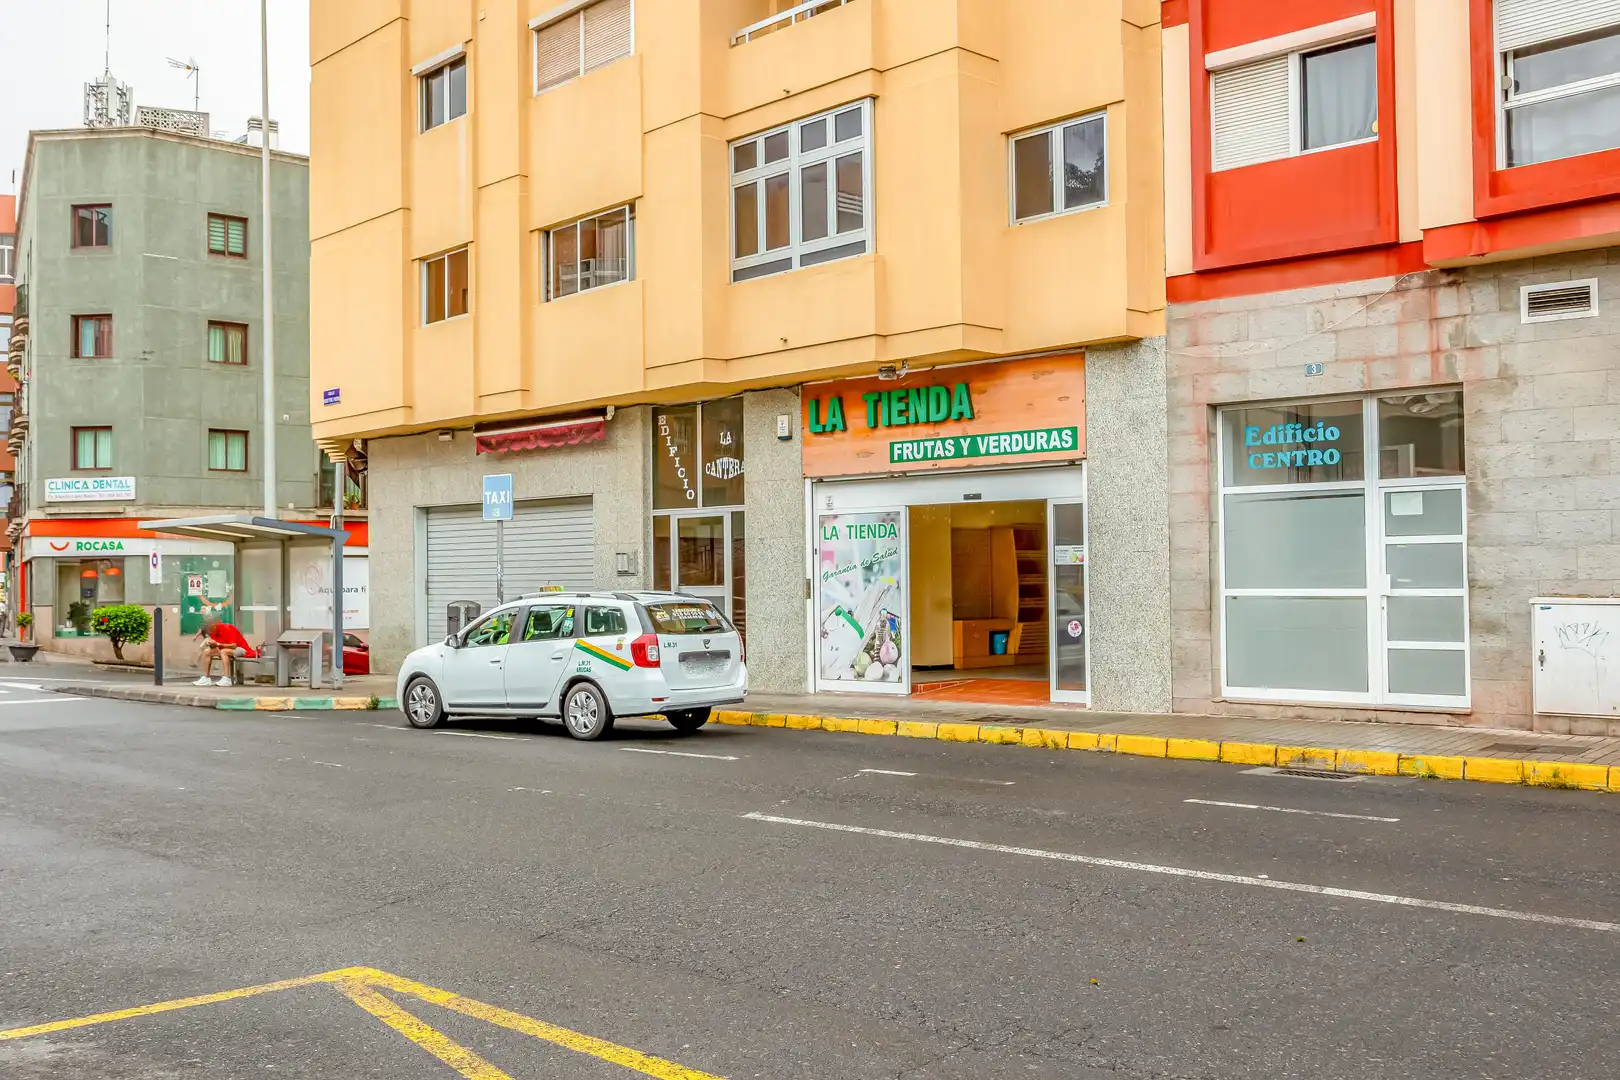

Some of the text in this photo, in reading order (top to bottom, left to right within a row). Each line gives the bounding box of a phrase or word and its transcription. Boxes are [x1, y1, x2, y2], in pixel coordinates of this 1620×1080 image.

[1311, 364, 1317, 374] 3
[808, 383, 975, 433] LA TIENDA
[720, 431, 732, 446] LA
[1244, 421, 1340, 447] Edificio
[893, 429, 1073, 461] FRUTAS Y VERDURAS
[658, 415, 695, 500] EDIFICIO
[1247, 448, 1341, 469] CENTRO
[48, 479, 131, 491] CLINICA DENTAL
[485, 490, 510, 505] TAXI
[823, 523, 898, 540] LA TIENDA
[76, 541, 124, 551] ROCASA
[860, 558, 870, 567] de
[872, 547, 898, 562] Salud
